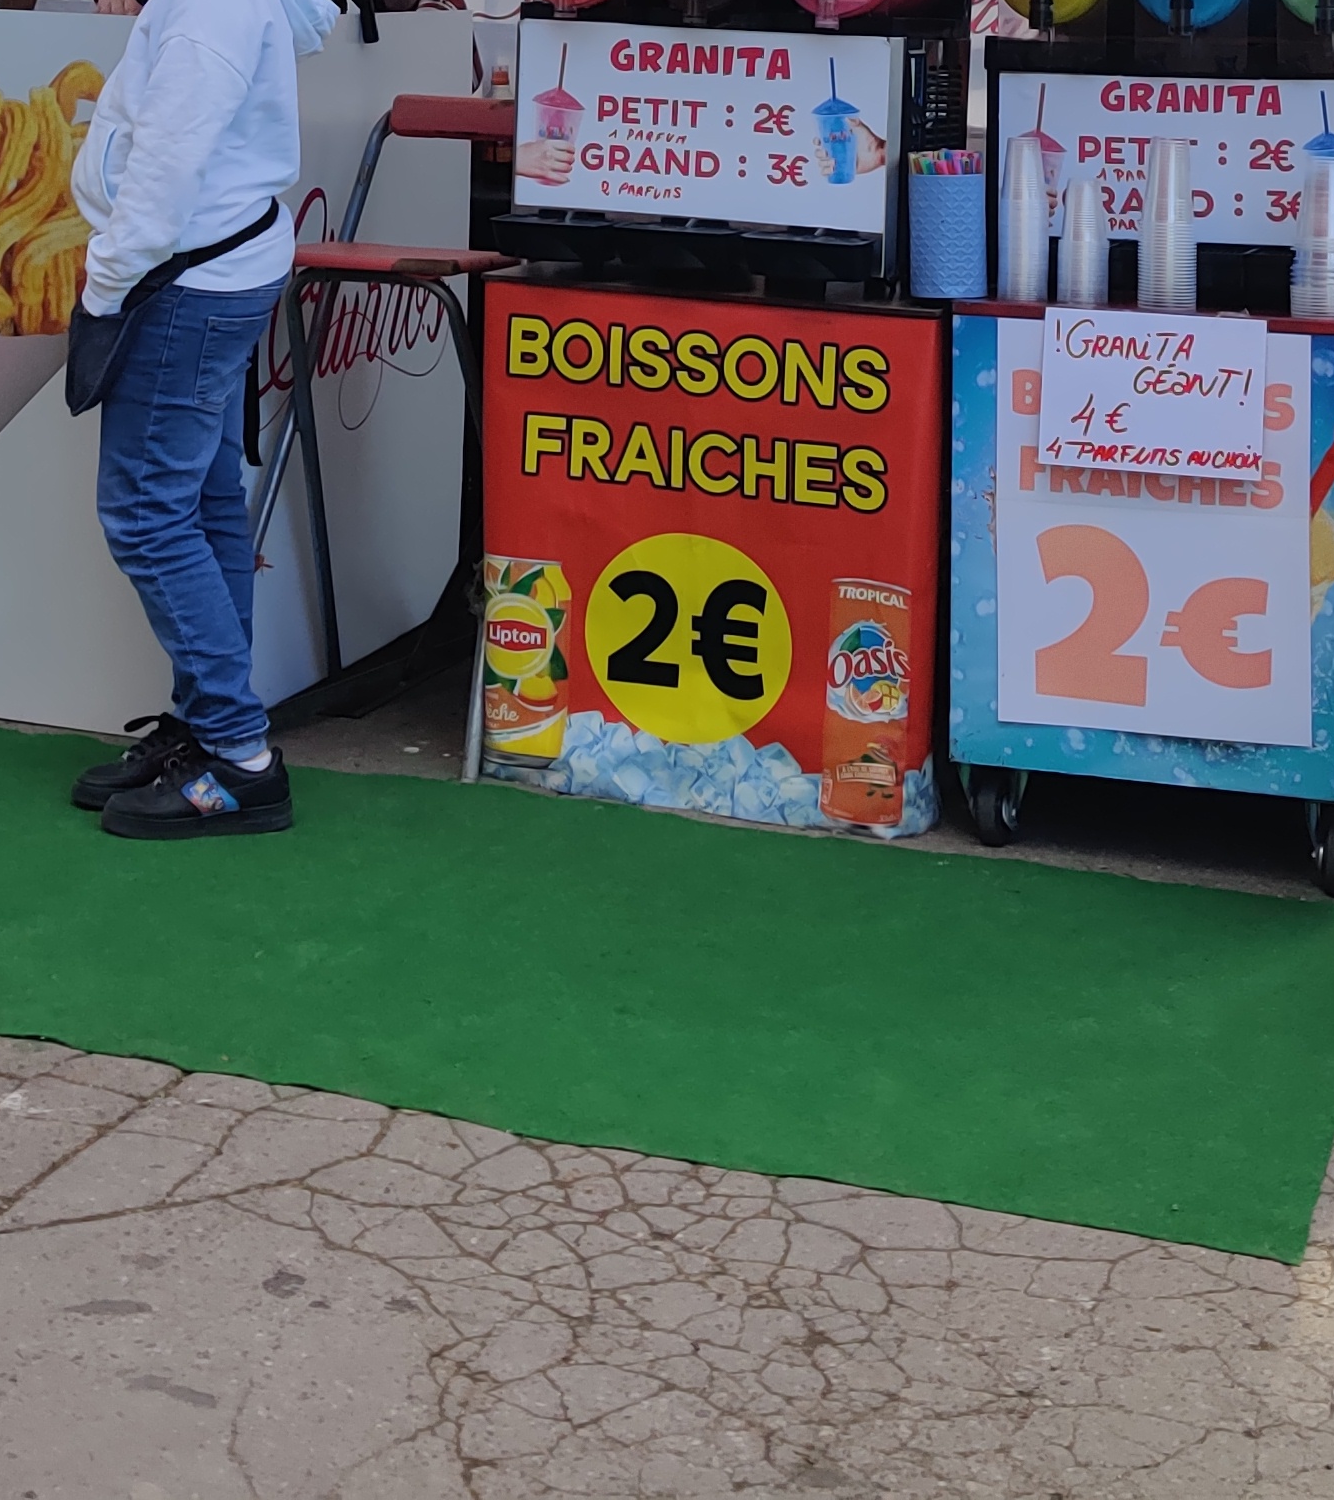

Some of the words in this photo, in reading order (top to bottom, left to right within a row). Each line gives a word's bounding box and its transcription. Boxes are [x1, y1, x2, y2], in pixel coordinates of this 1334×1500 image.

[609, 38, 792, 81] GRANITA
[596, 95, 708, 129] PETIT
[753, 103, 797, 137] 2€
[1099, 80, 1282, 116] GRANITA
[626, 129, 688, 144] PARFUM
[1249, 138, 1296, 173] 2€
[579, 142, 721, 179] GRAND
[766, 153, 810, 188] 3€
[618, 182, 682, 200] PARFUMS
[506, 313, 891, 411] BOISSONS
[1070, 392, 1095, 437] 4
[1105, 402, 1131, 433] €
[521, 411, 889, 514] FRAICHES
[1046, 436, 1061, 460] 4
[1065, 440, 1182, 467] PARFUMS
[837, 584, 909, 610] TROPICAL
[1034, 523, 1273, 708] 2€
[488, 624, 542, 647] Lipton
[606, 569, 769, 702] 2€
[828, 640, 911, 688] Oasis
